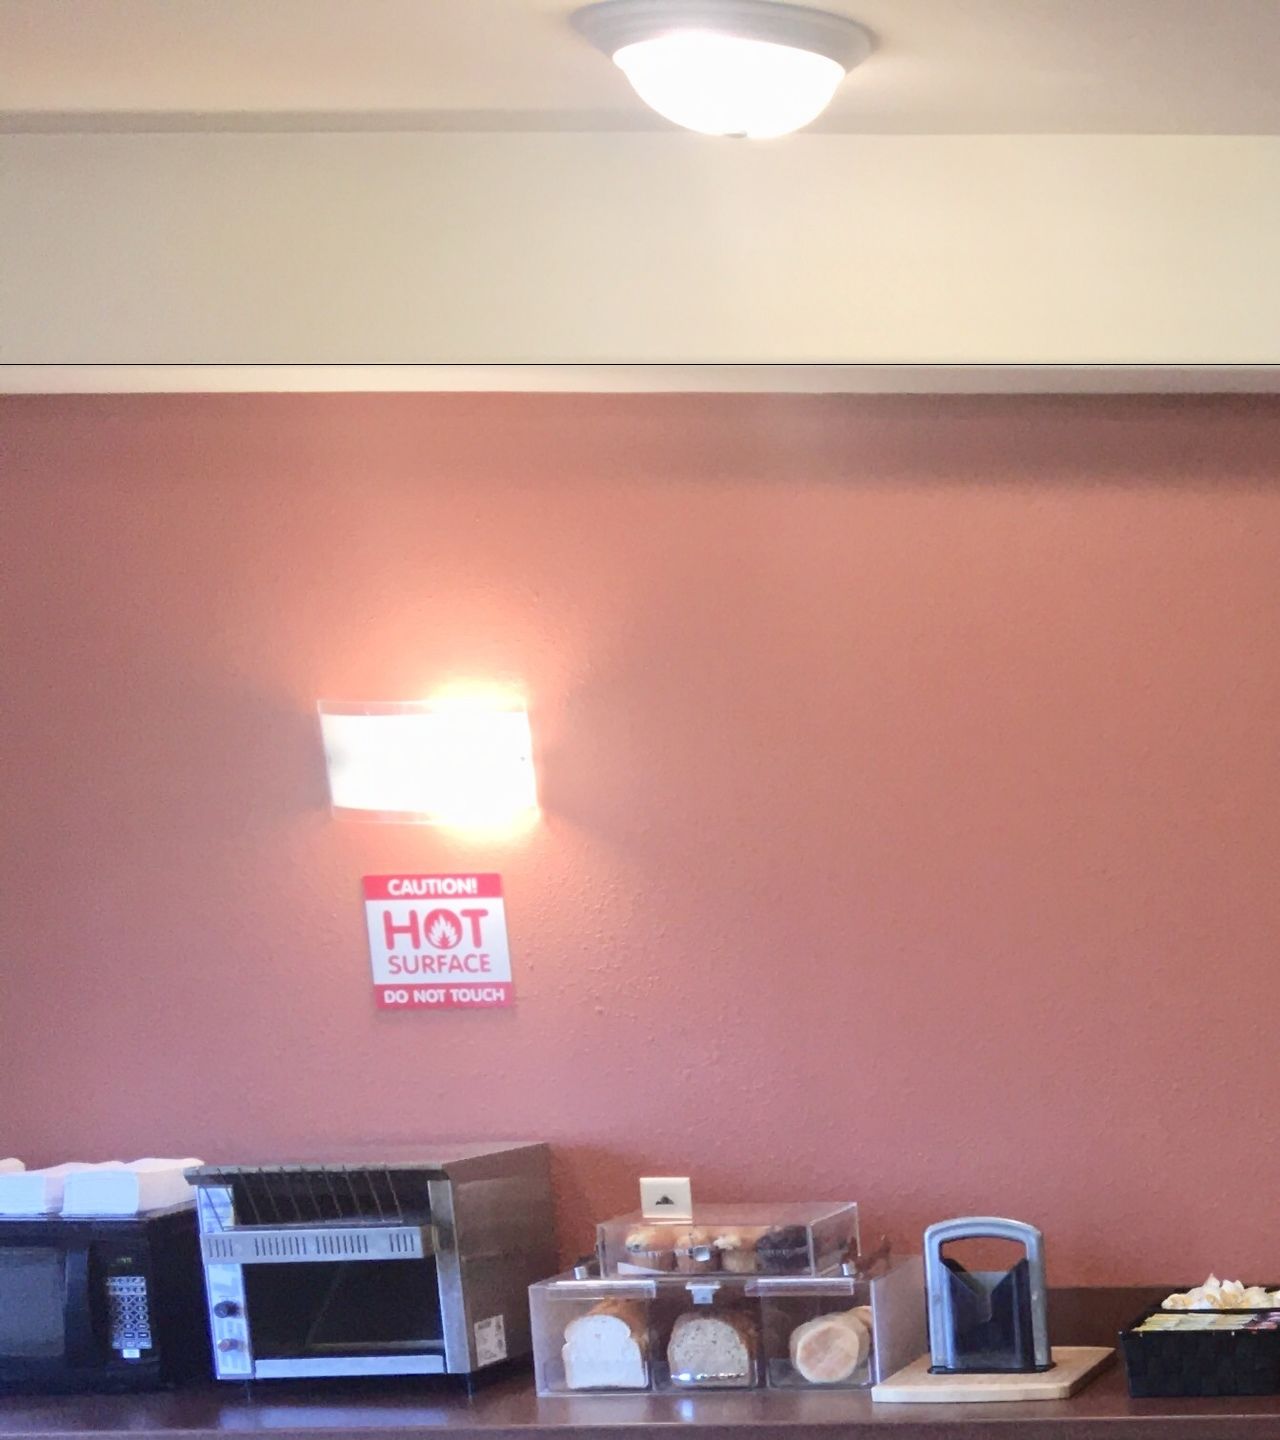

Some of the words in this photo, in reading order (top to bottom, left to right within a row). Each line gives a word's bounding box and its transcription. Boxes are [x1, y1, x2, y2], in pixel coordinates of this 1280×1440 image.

[387, 878, 478, 896] CAUTION!
[383, 908, 489, 950] HOT
[388, 953, 492, 975] SURFACE
[383, 990, 409, 1003] DO
[413, 989, 447, 1003] NOT
[449, 988, 504, 1002] TOUCH
